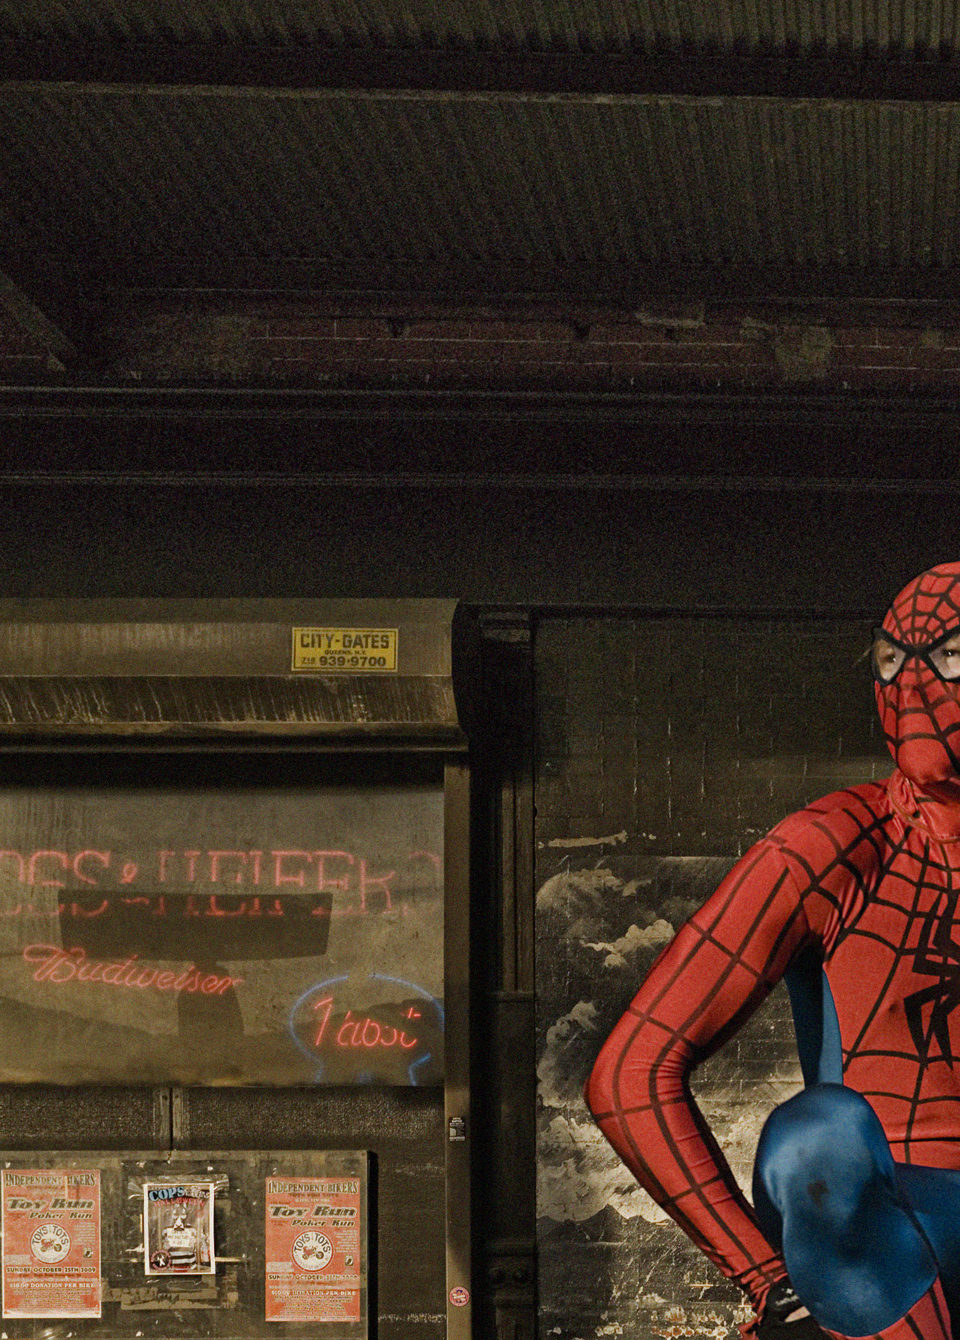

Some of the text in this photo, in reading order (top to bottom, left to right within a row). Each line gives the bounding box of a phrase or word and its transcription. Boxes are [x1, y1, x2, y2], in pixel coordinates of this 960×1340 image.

[301, 633, 389, 649] CITY-GATES
[23, 943, 245, 995] Budweiser
[149, 1186, 184, 1201] COPS
[268, 1180, 359, 1194] INDEPENDENT BIKERS
[7, 1197, 95, 1211] Toy Run
[269, 1204, 357, 1218] Toy Run
[32, 1225, 49, 1244] TOYS
[53, 1225, 69, 1244] TOTS
[294, 1233, 311, 1252] TOYS
[315, 1233, 331, 1253] TOTS
